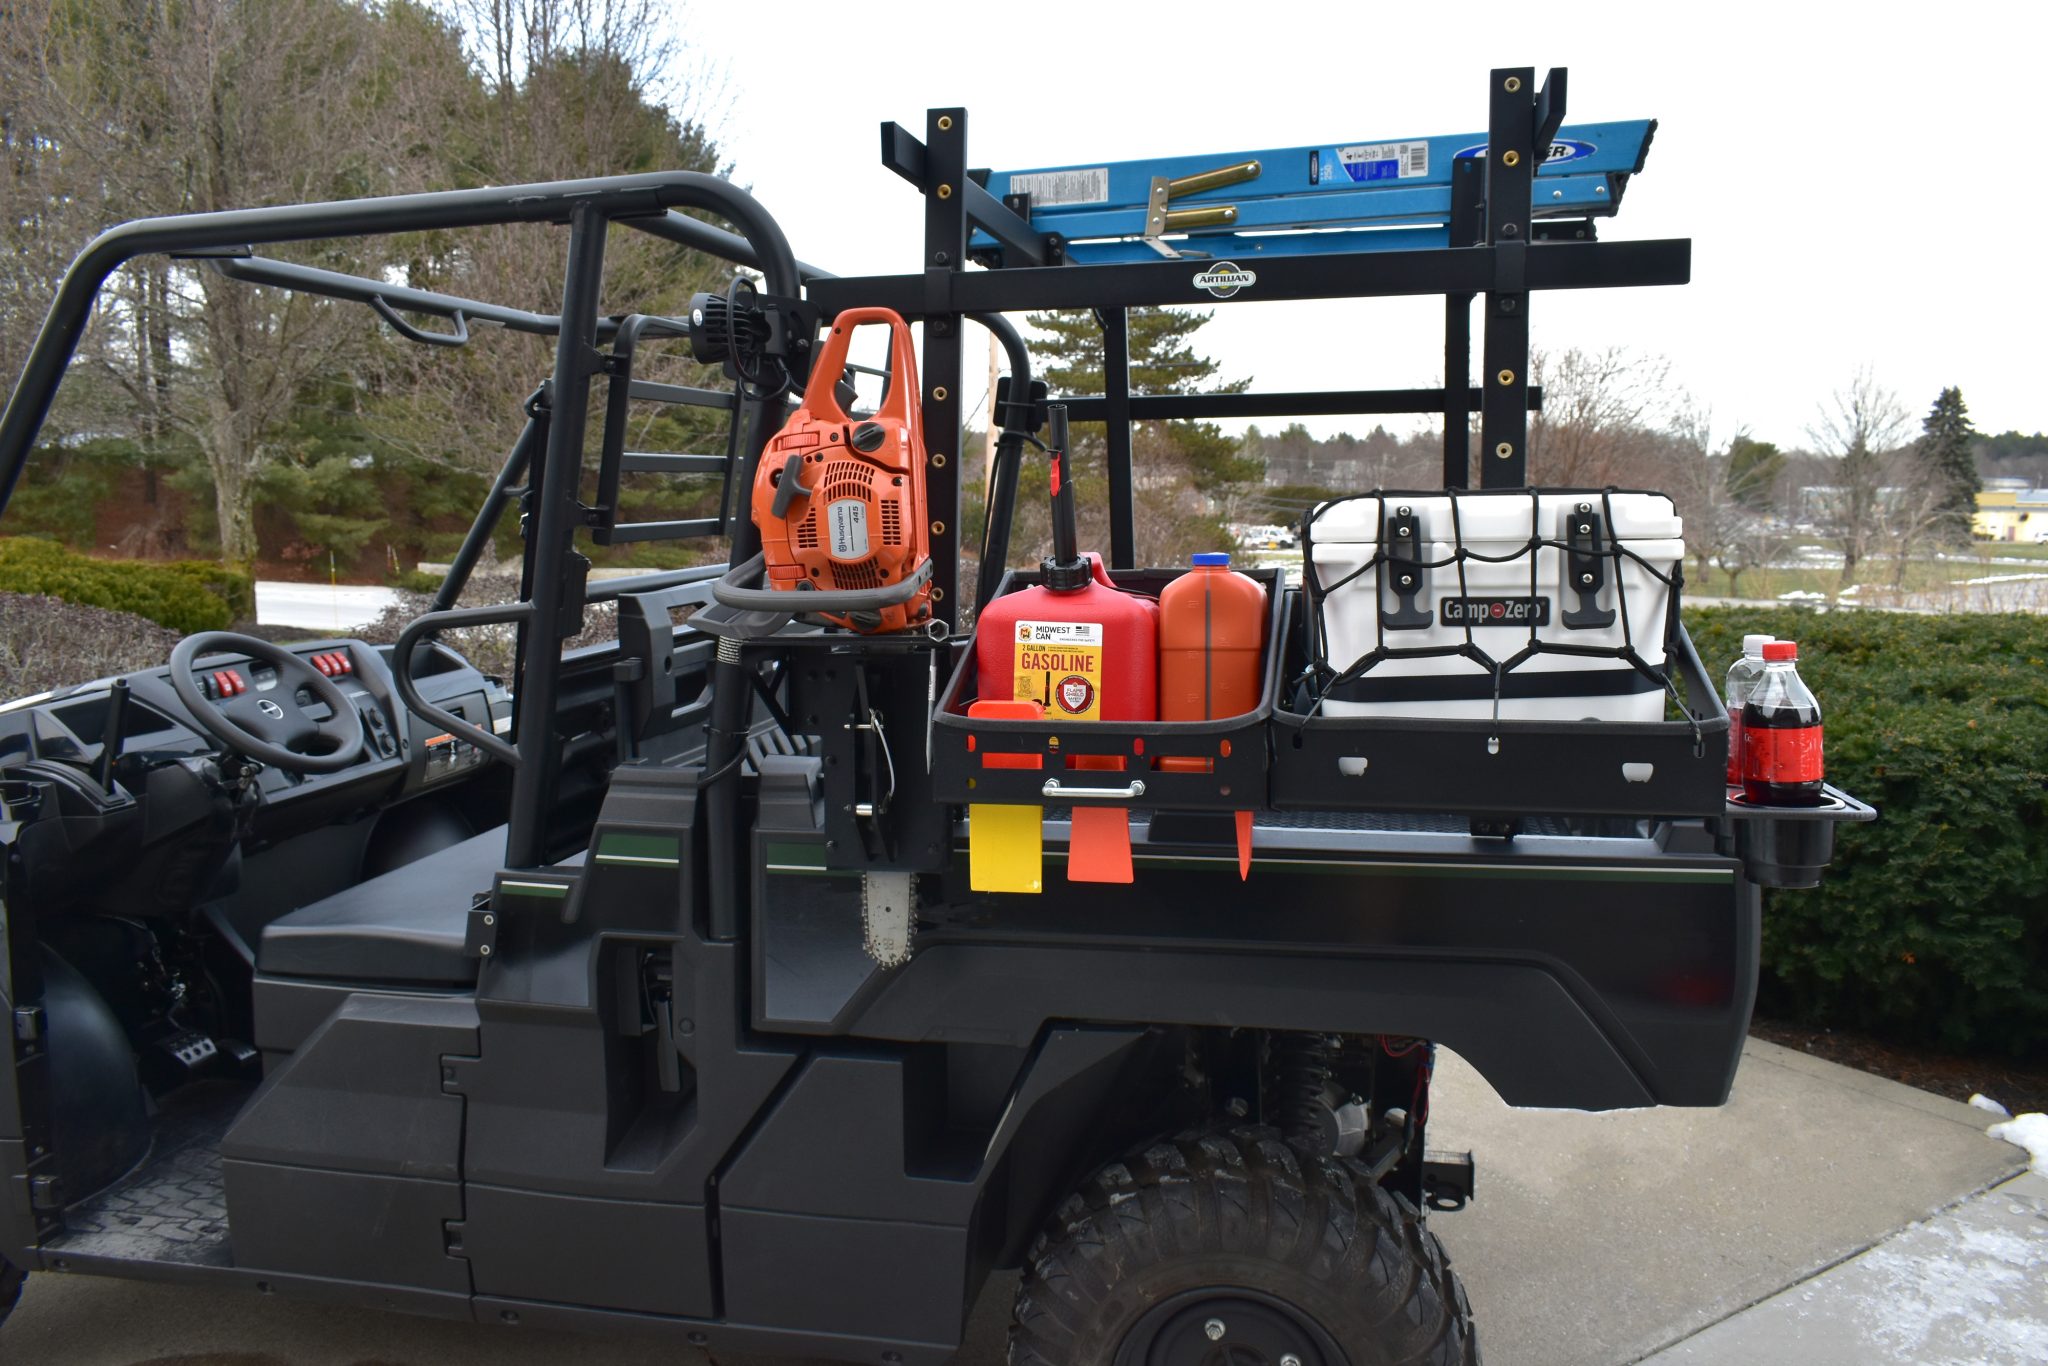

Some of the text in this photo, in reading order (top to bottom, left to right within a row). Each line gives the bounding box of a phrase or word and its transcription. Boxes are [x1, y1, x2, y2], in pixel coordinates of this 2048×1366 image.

[852, 505, 860, 523] 445
[837, 506, 846, 545] Husqvarna
[1036, 625, 1070, 633] MIDWEST
[1021, 653, 1094, 672] GASOLINE
